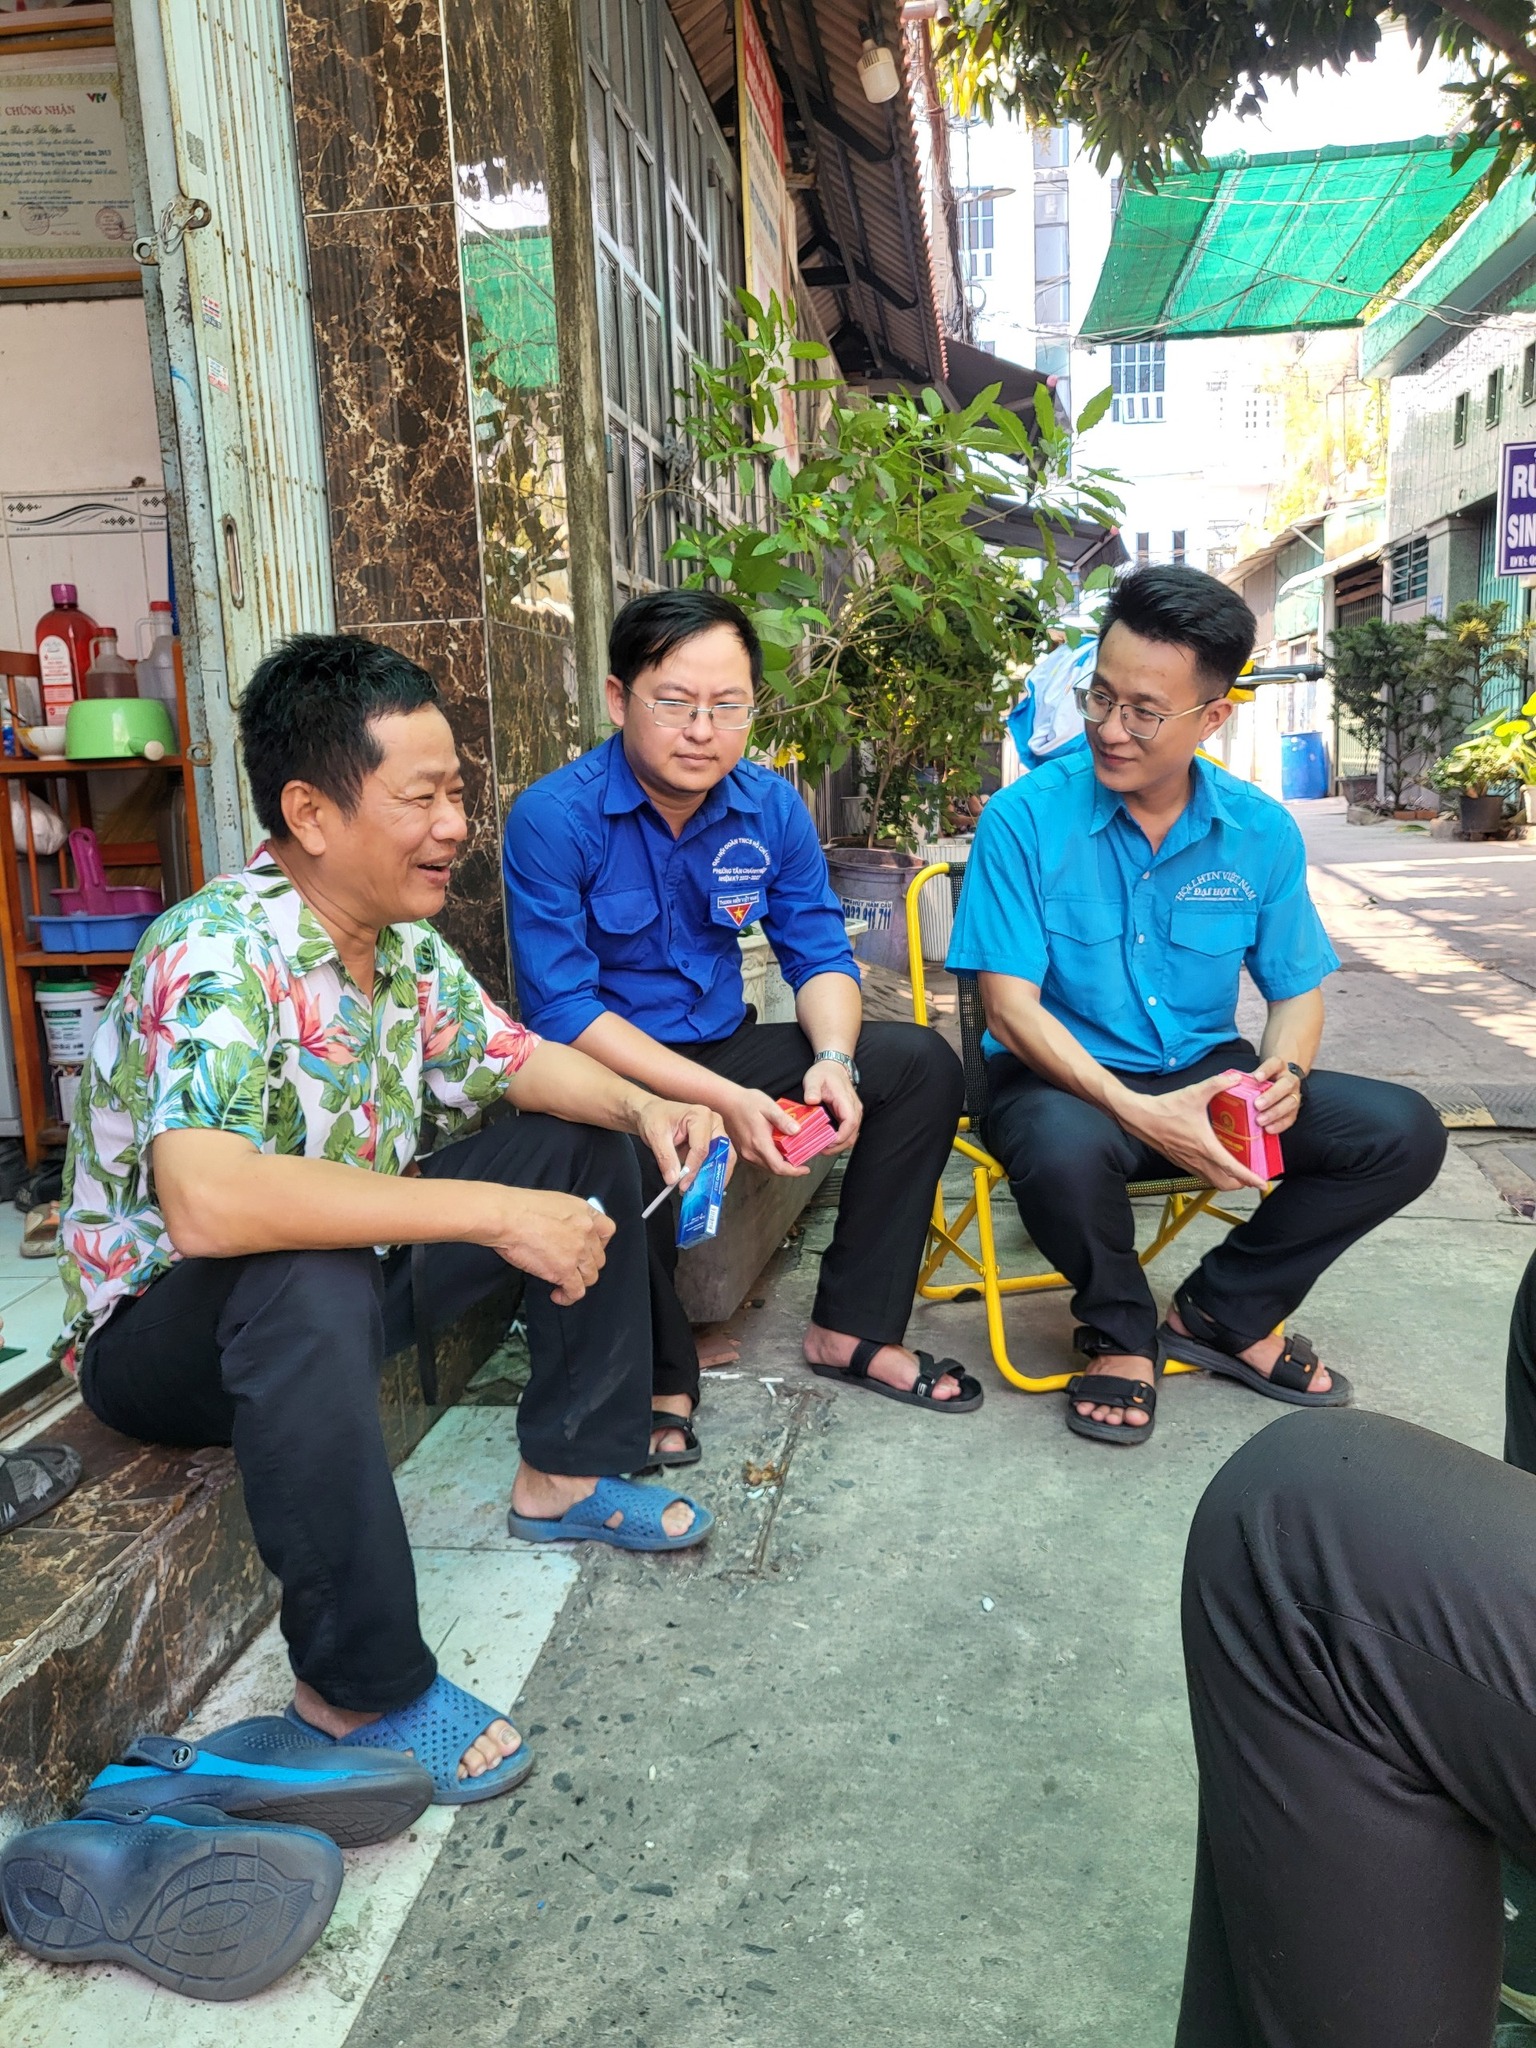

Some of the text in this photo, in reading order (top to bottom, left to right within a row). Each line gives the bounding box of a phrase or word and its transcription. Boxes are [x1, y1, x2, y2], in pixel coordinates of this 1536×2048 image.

[87, 92, 107, 103] VTV
[45, 104, 76, 117] NHẬN
[1232, 888, 1239, 896] V
[1238, 879, 1257, 901] NAM
